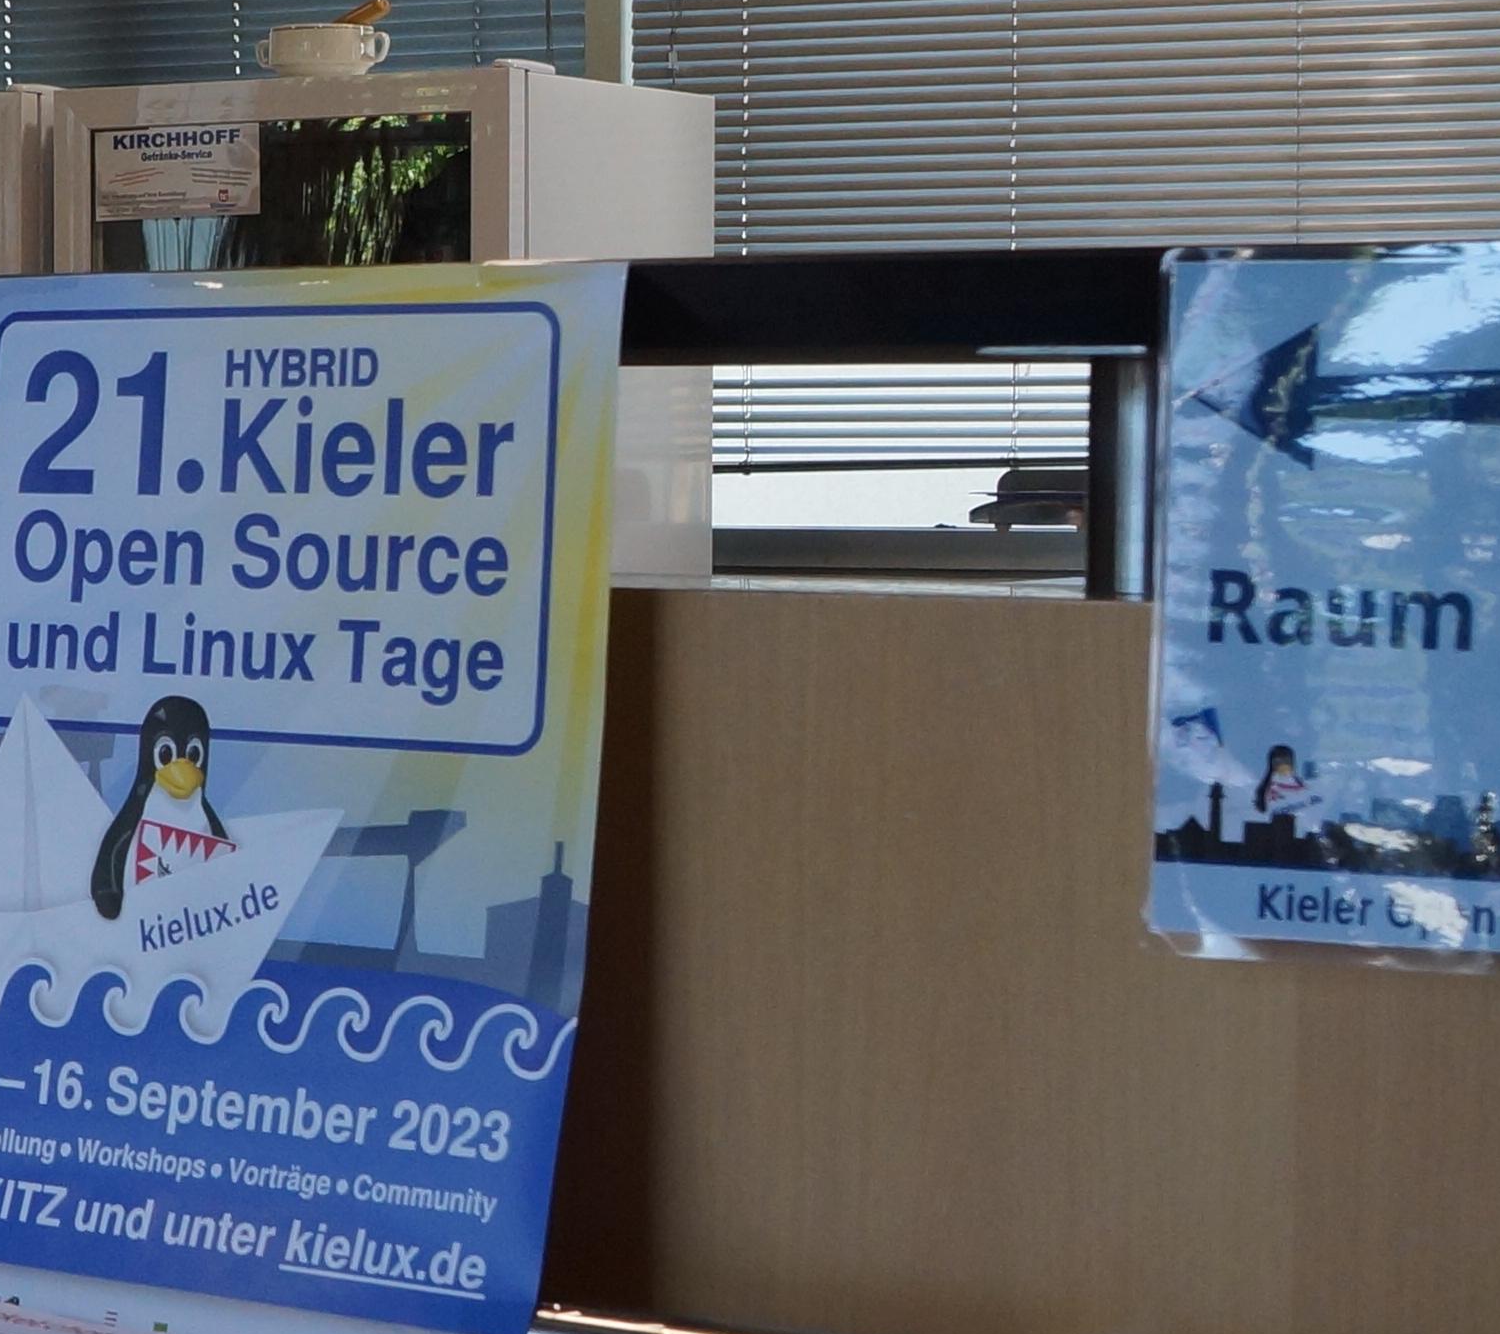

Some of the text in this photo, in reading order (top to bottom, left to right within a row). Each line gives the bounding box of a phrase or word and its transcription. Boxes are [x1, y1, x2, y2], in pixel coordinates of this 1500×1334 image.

[113, 129, 240, 150] KIRCHHOFF
[225, 348, 379, 389] HYBRID
[18, 350, 515, 499] 21. Kieler
[14, 509, 509, 602] Open Source
[1206, 568, 1474, 653] Raum
[8, 612, 504, 706] und Linux Tage
[139, 881, 281, 953] kielux.de
[1256, 881, 1373, 930] Kieler
[105, 1066, 378, 1147] September
[391, 1100, 512, 1163] 2023
[76, 1135, 206, 1181] Workshops
[228, 1157, 332, 1199] Vorträge
[353, 1174, 498, 1223] Community
[74, 1199, 155, 1243] und
[162, 1214, 277, 1261] unter
[283, 1219, 487, 1292] kielux.de
